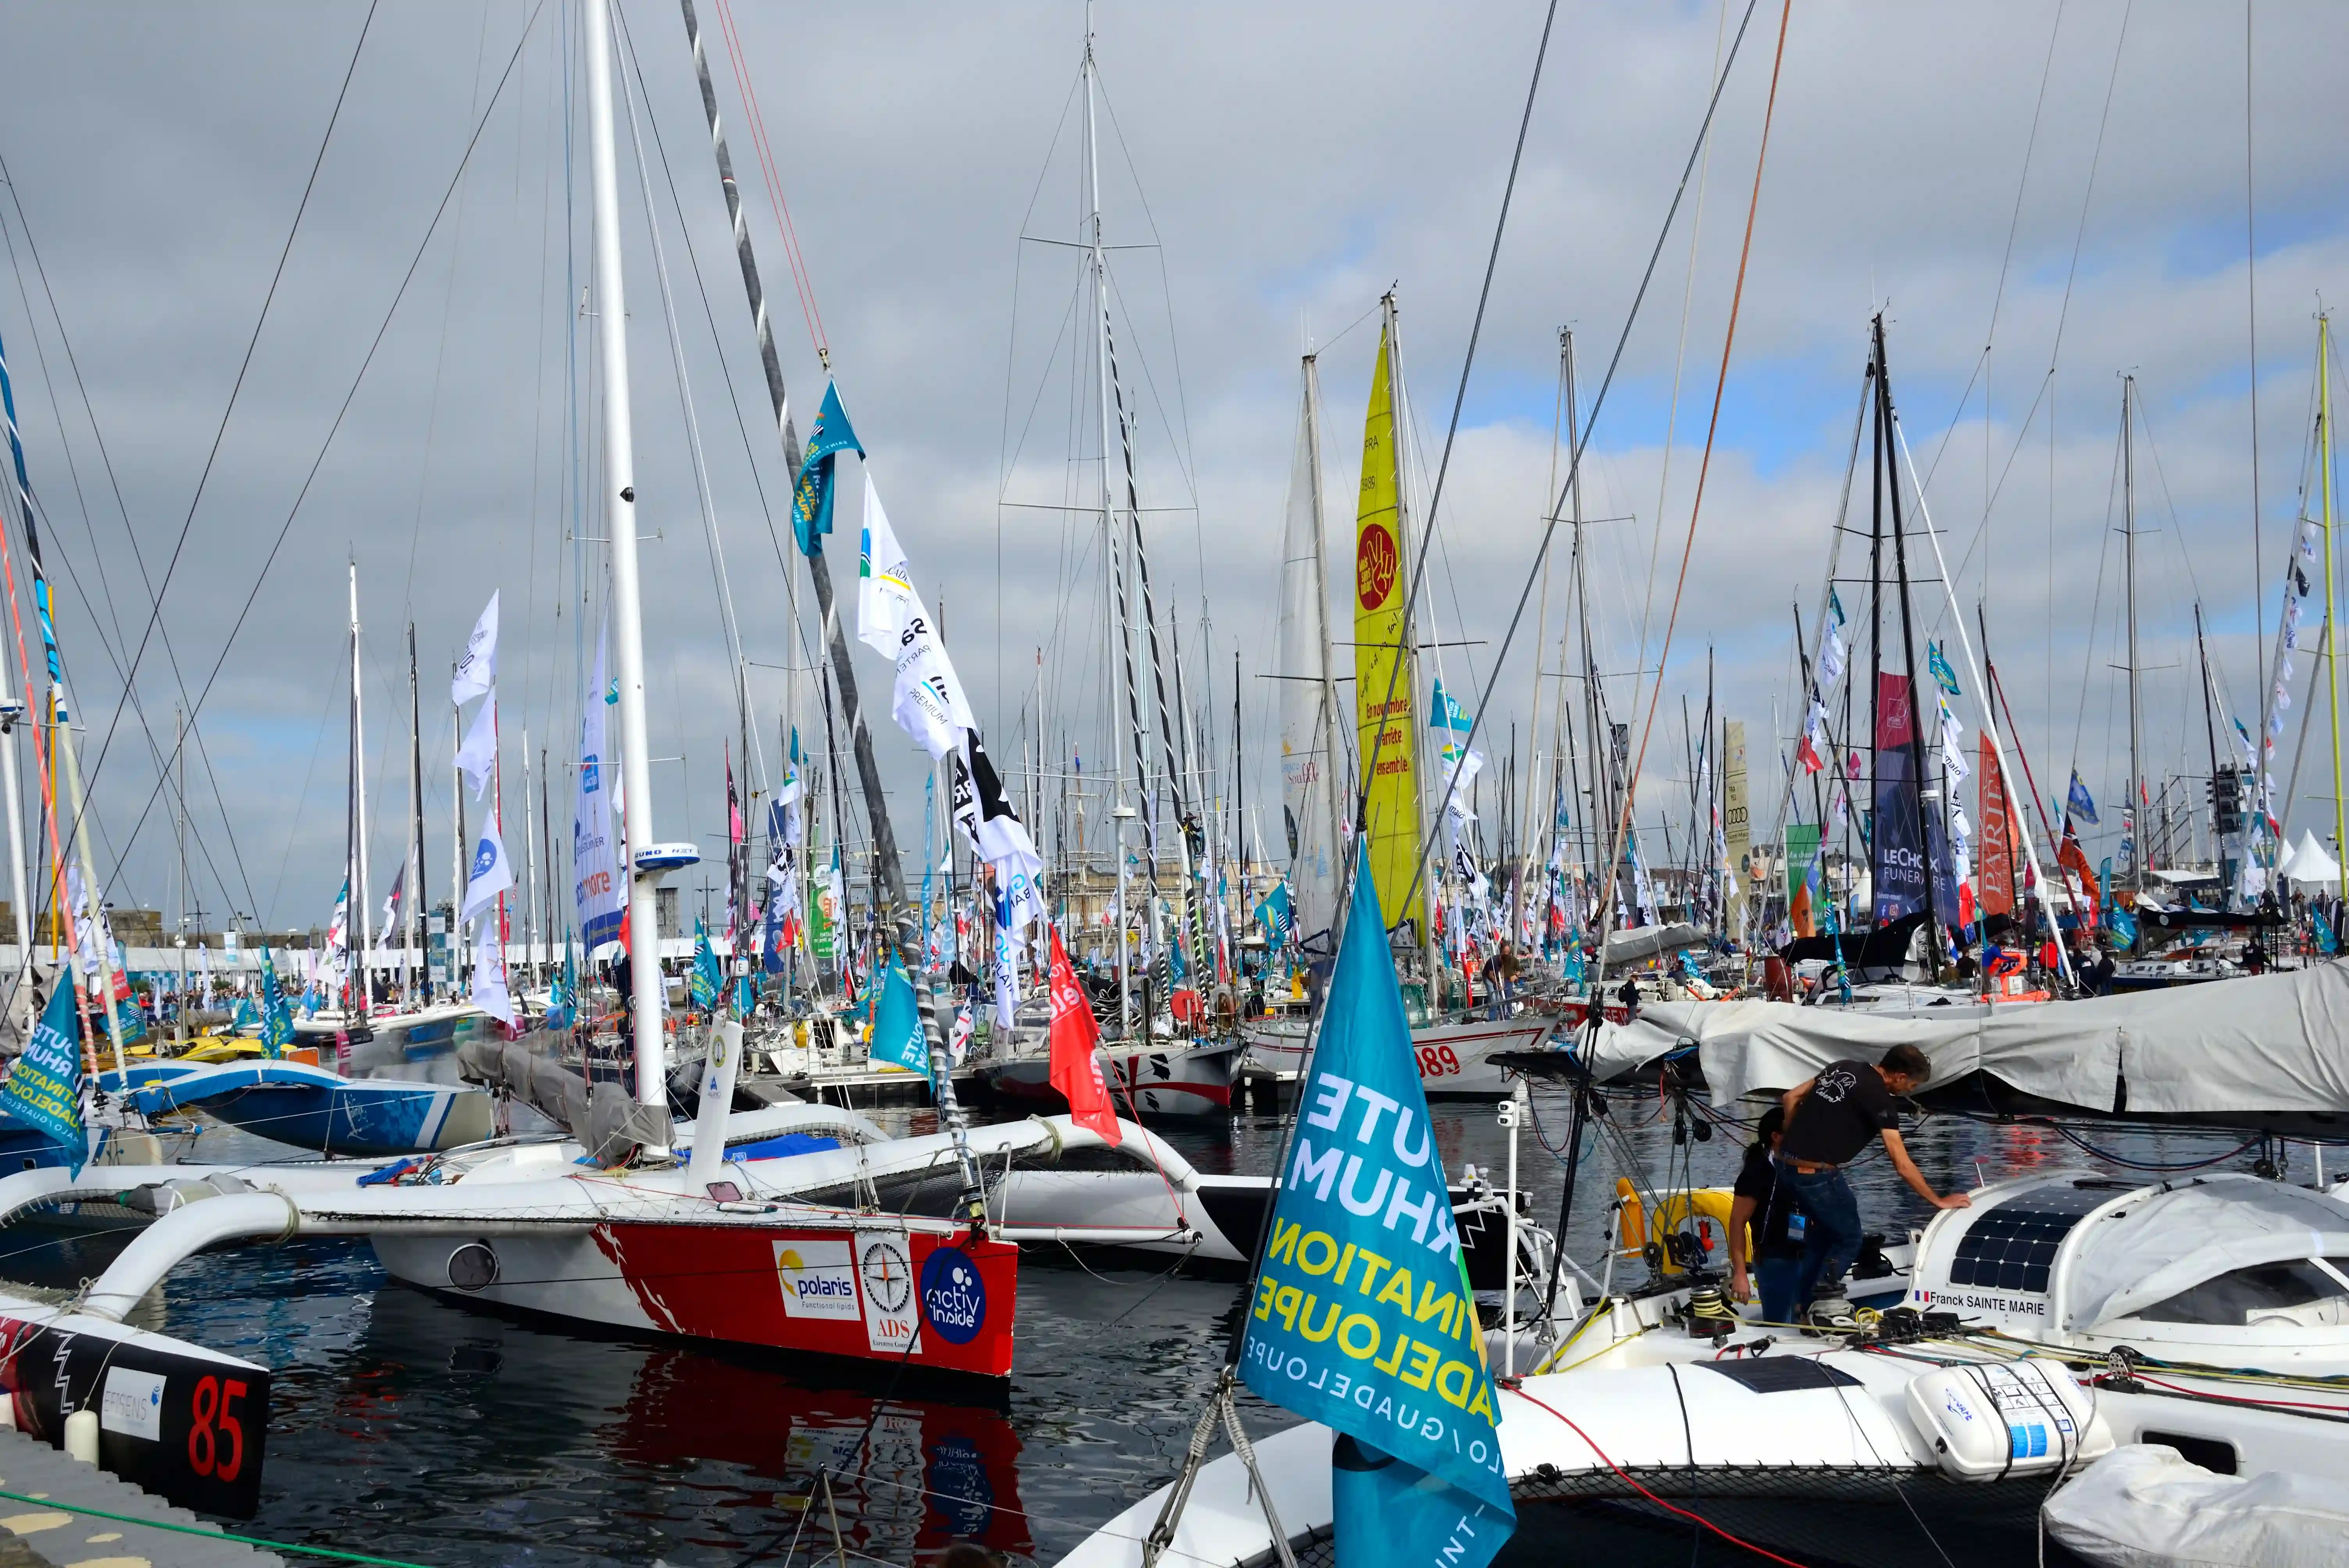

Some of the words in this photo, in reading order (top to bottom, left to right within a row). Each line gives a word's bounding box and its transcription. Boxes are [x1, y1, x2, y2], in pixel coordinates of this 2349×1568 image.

[1365, 436, 1379, 453] FRA
[1361, 476, 1376, 491] 3989
[908, 688, 948, 725] PREMIUM
[1367, 703, 1373, 719] En
[1374, 696, 1411, 718] novmbre,
[1945, 755, 1961, 776] malo
[1449, 805, 1465, 819] malo
[738, 963, 743, 971] E
[798, 1275, 853, 1299] polaris
[802, 1301, 834, 1310] Functional
[836, 1302, 855, 1311] lipids
[1930, 1292, 1964, 1306] Franck
[1967, 1295, 2005, 1311] SAINTE
[2009, 1300, 2044, 1315] MARIE
[877, 1319, 910, 1339] ADS
[104, 1391, 147, 1420] EFISENS
[189, 1375, 248, 1483] 85
